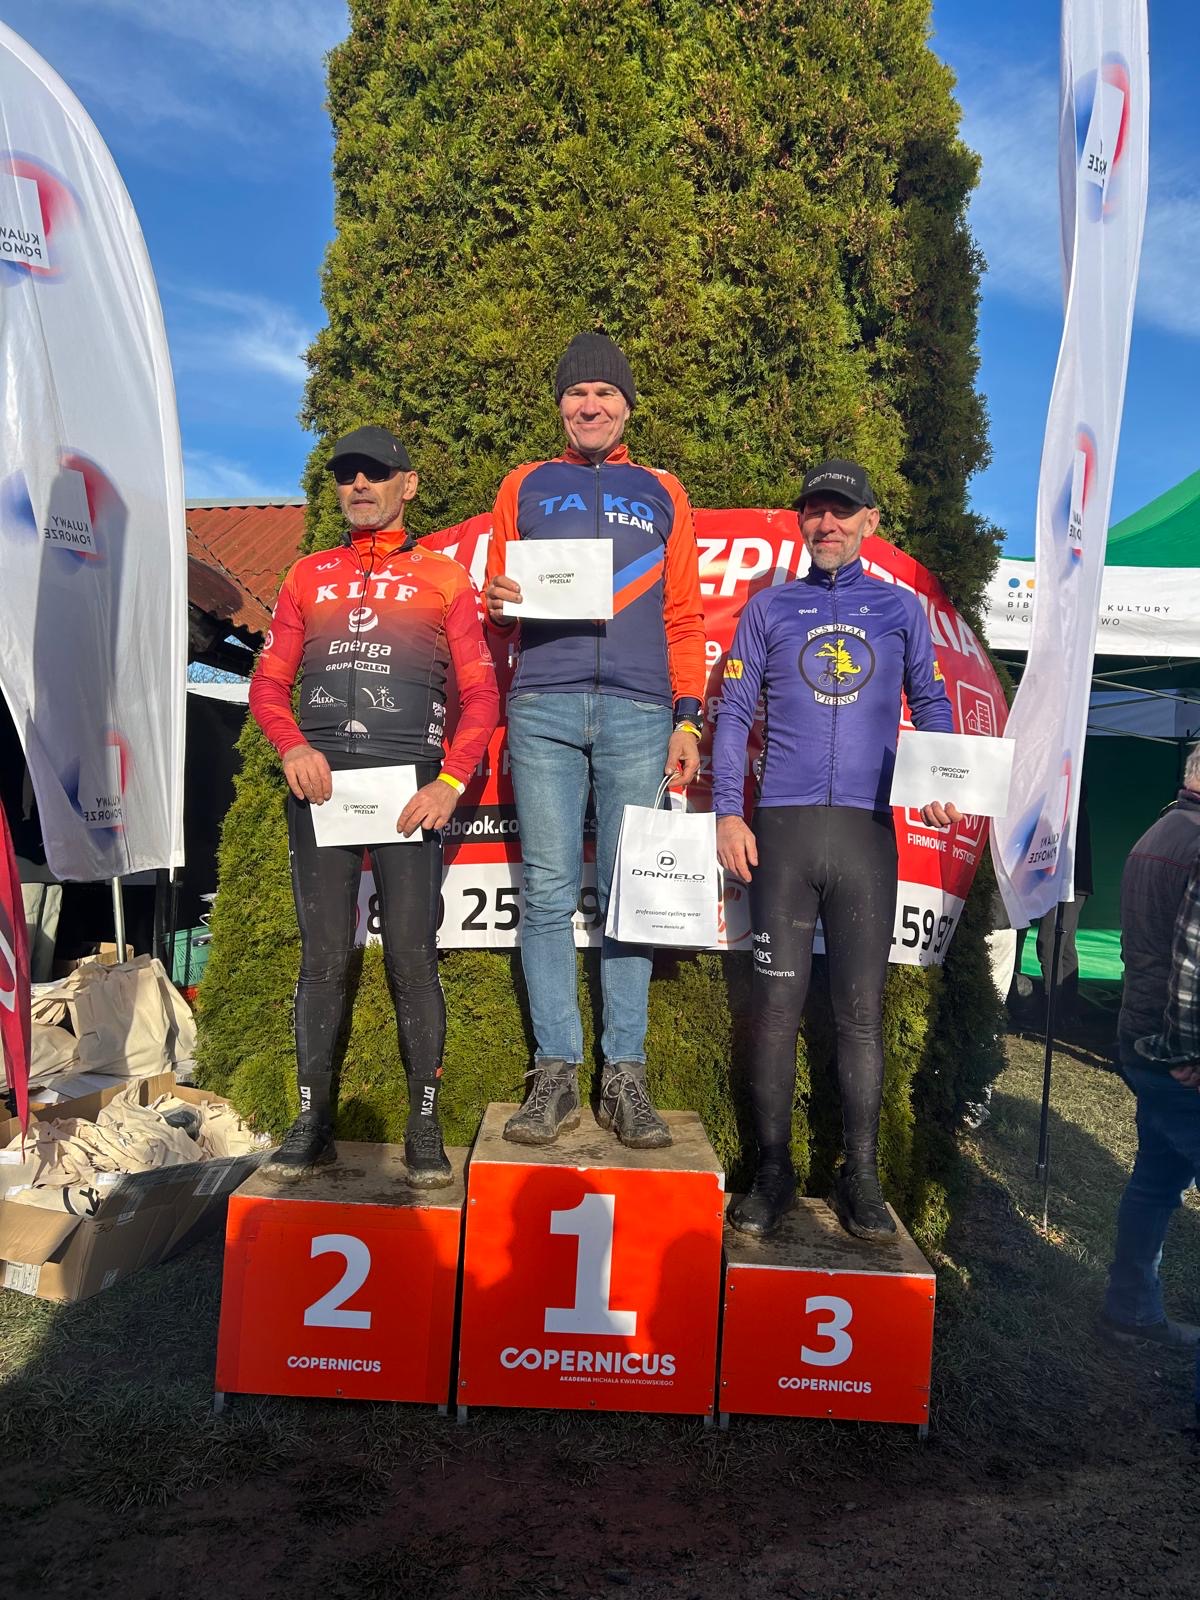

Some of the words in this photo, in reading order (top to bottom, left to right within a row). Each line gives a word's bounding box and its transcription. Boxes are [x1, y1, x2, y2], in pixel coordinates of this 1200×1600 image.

[604, 511, 654, 534] TEAM
[315, 581, 418, 604] KLIF
[1107, 604, 1171, 613] KULTURY
[808, 625, 829, 639] ACS
[328, 640, 392, 658] Energa
[325, 662, 353, 671] GRUPA
[356, 661, 389, 674] ORLEN
[907, 833, 947, 852] FIRMOWE
[631, 869, 706, 881] DANIELO
[461, 887, 521, 931] 25
[543, 1193, 637, 1337] 1
[303, 1233, 372, 1330] 2
[800, 1295, 853, 1367] 3
[287, 1355, 382, 1373] COPERNICUS
[500, 1347, 676, 1376] COPERNICUS
[559, 1375, 592, 1383] AKADEMIA
[778, 1376, 872, 1393] COPERNICUS
